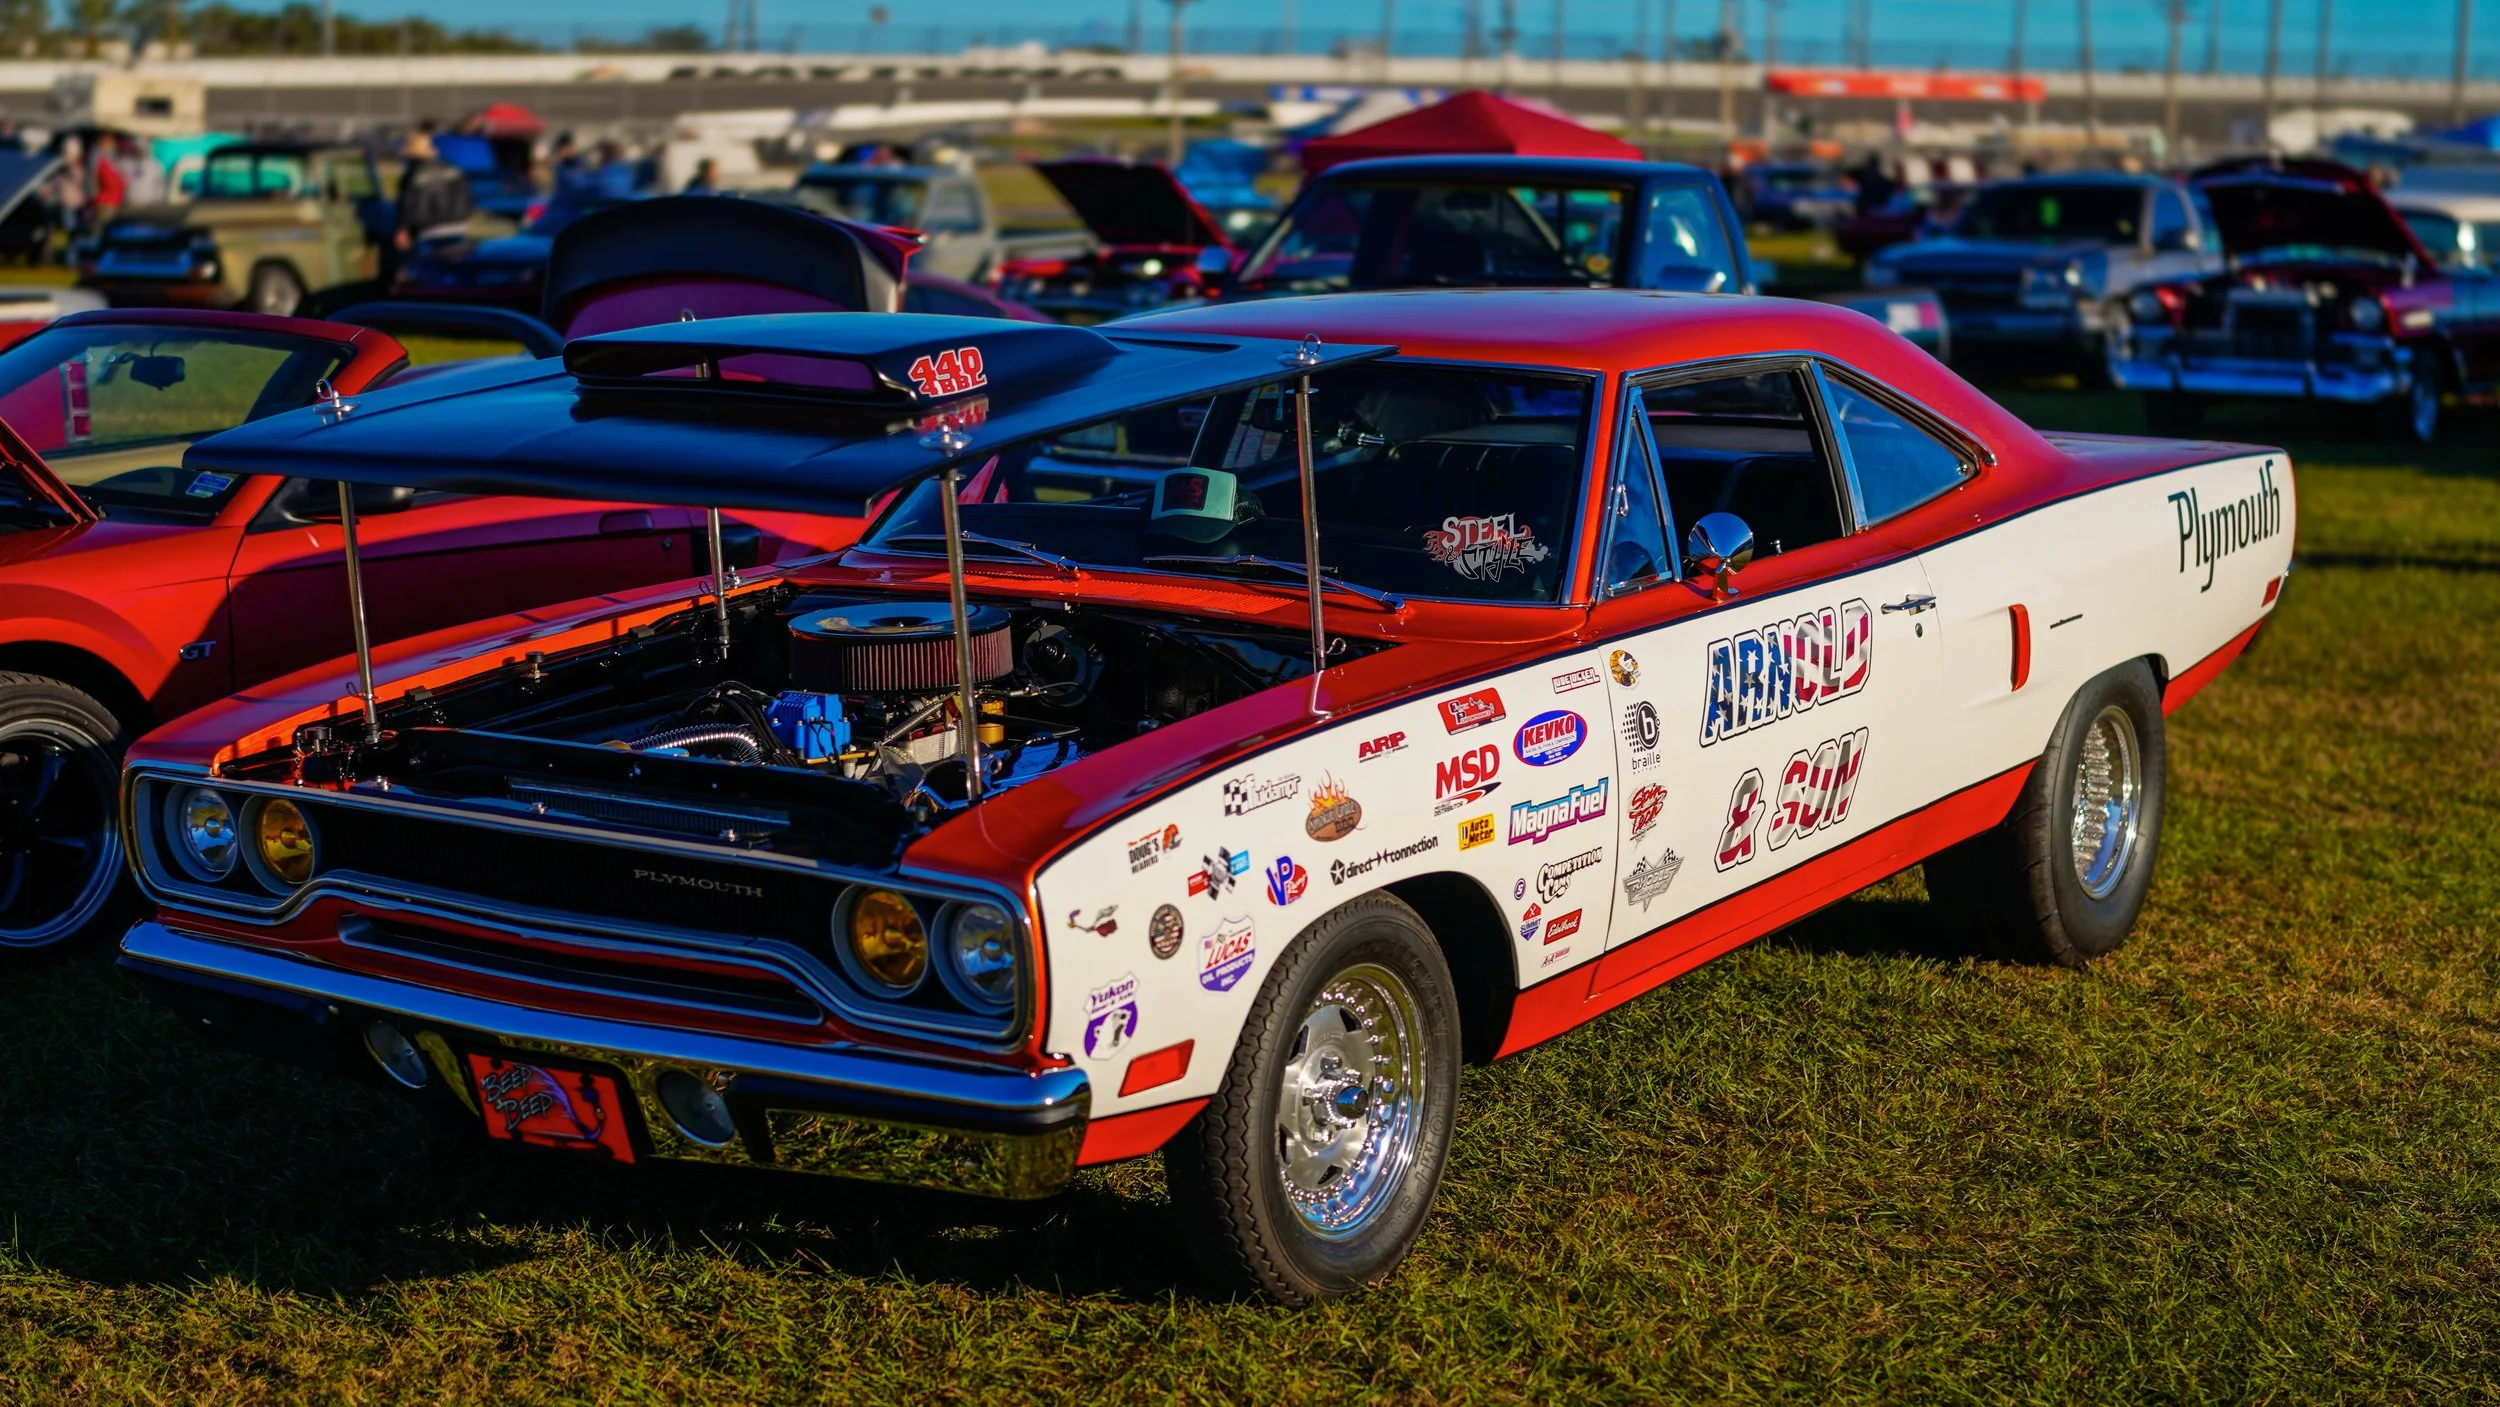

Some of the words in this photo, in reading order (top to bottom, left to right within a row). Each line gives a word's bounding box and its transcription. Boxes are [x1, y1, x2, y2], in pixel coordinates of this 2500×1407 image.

[908, 347, 984, 382] 440
[1441, 512, 1527, 551] STEEL
[2167, 458, 2281, 593] Plymouth
[180, 640, 217, 660] GT
[1699, 598, 1873, 748] ARNOLD
[1359, 731, 1406, 759] ARP
[1523, 714, 1575, 749] KEVKO
[1435, 744, 1500, 800] MSD
[1632, 751, 1661, 770] braille
[1509, 777, 1608, 845] MagnaFuel
[1714, 767, 1766, 873] &
[1767, 727, 1869, 851] SON
[1470, 819, 1489, 832] Auto
[1470, 829, 1494, 843] Meter
[1390, 837, 1438, 863] connection
[633, 868, 763, 898] PLYMOUTH
[1266, 855, 1293, 906] VP
[1520, 918, 1541, 931] SUMMIT
[1206, 931, 1251, 968] LUCAS
[1201, 972, 1215, 984] OIL
[1215, 952, 1254, 978] PRODUCTS
[1091, 979, 1134, 1006] Yukon
[481, 1066, 533, 1103] BEEP
[496, 1091, 553, 1131] BEEP
